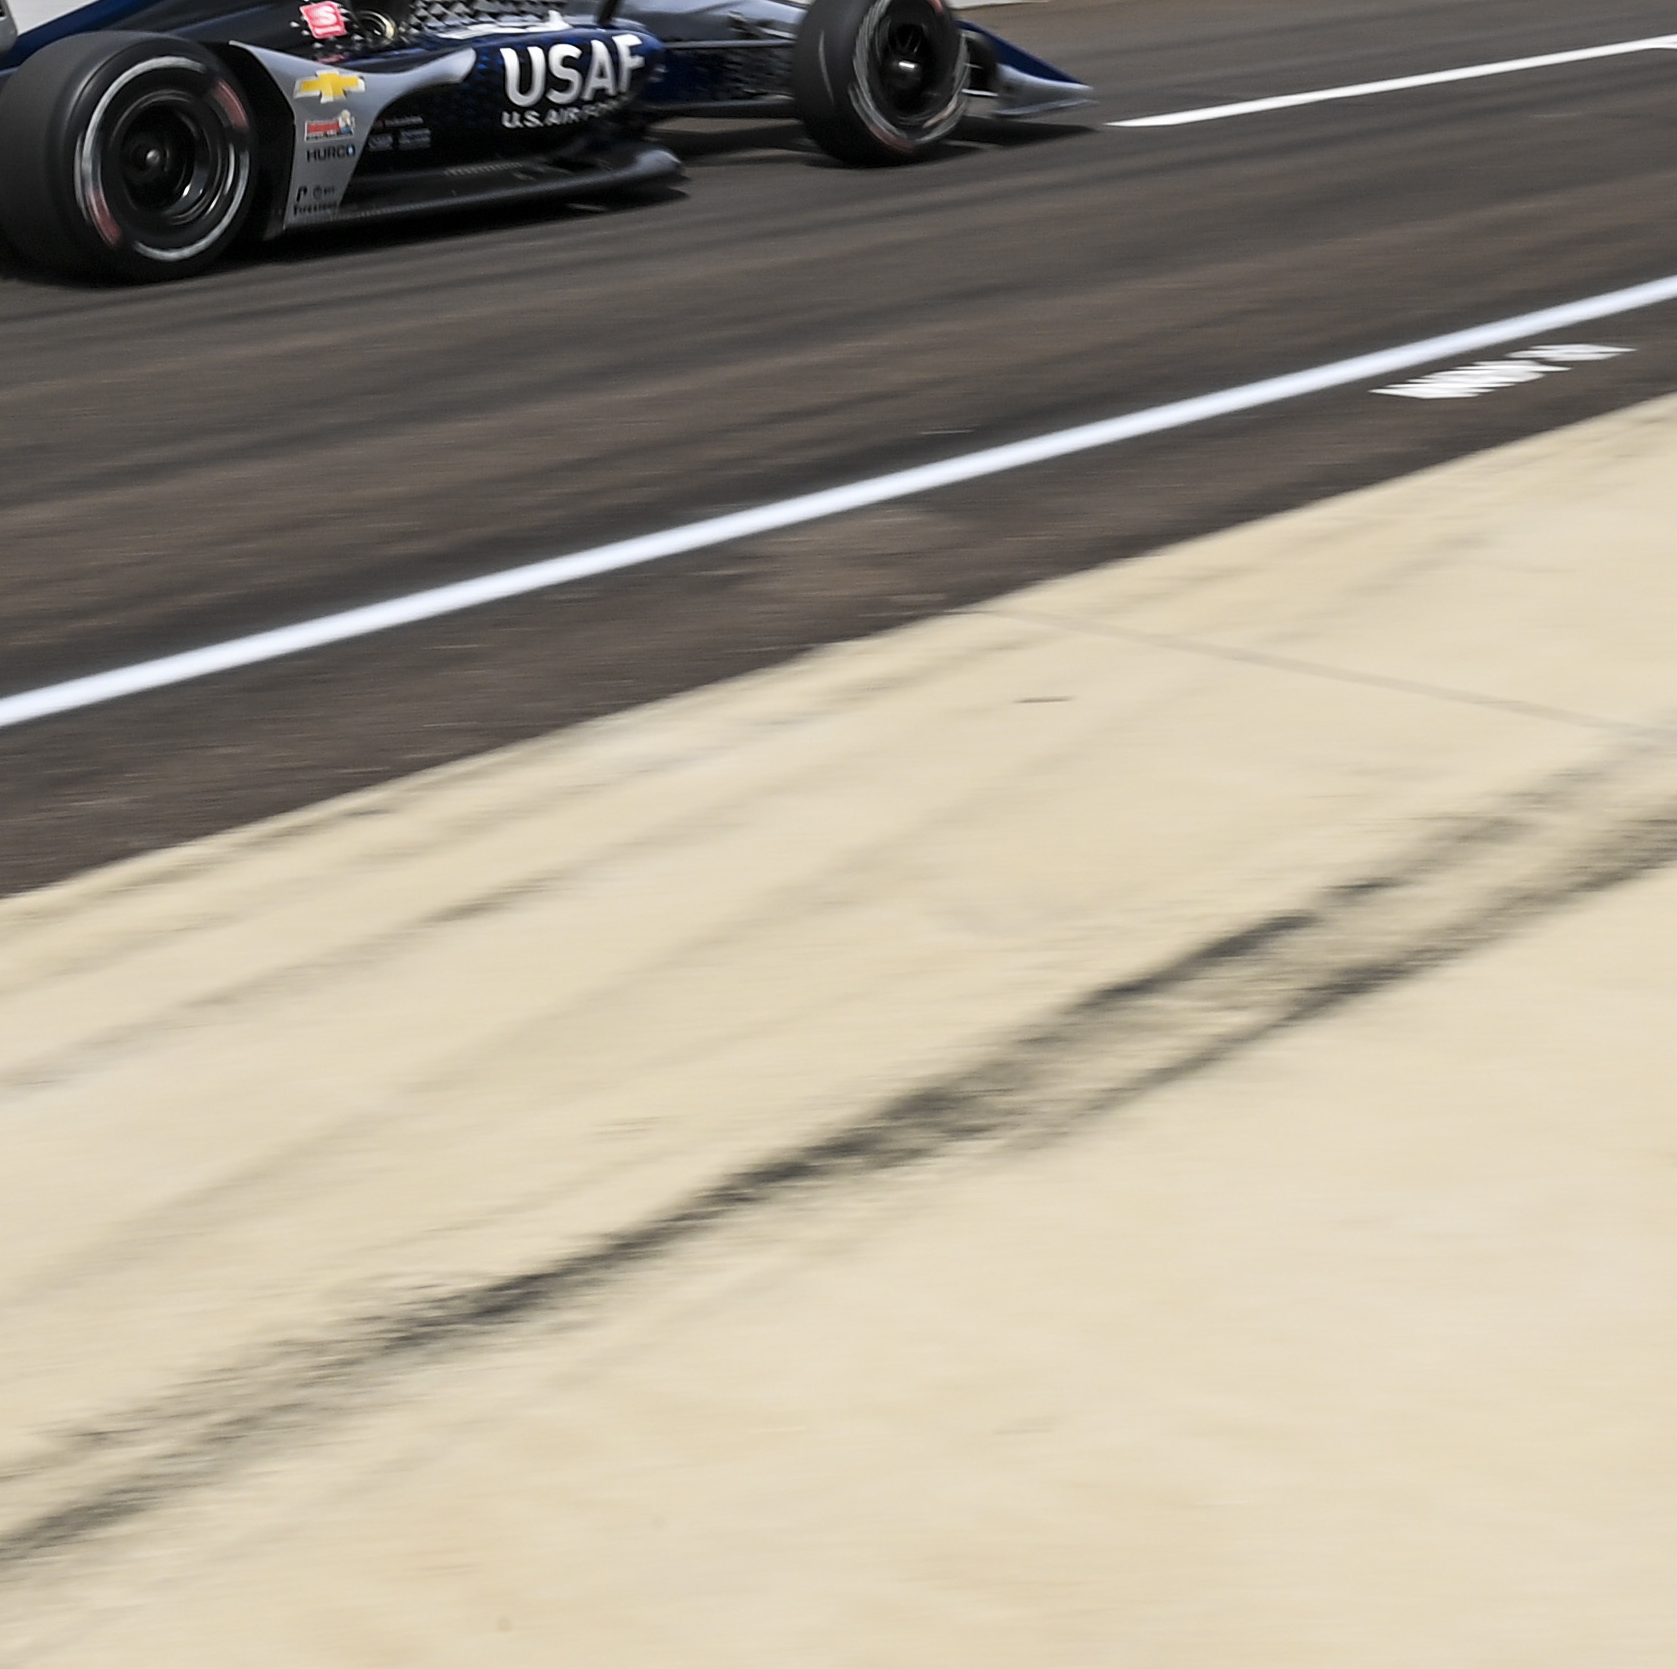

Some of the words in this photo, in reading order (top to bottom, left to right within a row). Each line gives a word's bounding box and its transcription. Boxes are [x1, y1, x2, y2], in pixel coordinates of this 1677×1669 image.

[500, 34, 645, 108] USAF
[544, 106, 582, 126] AIR
[306, 144, 355, 163] HURCO
